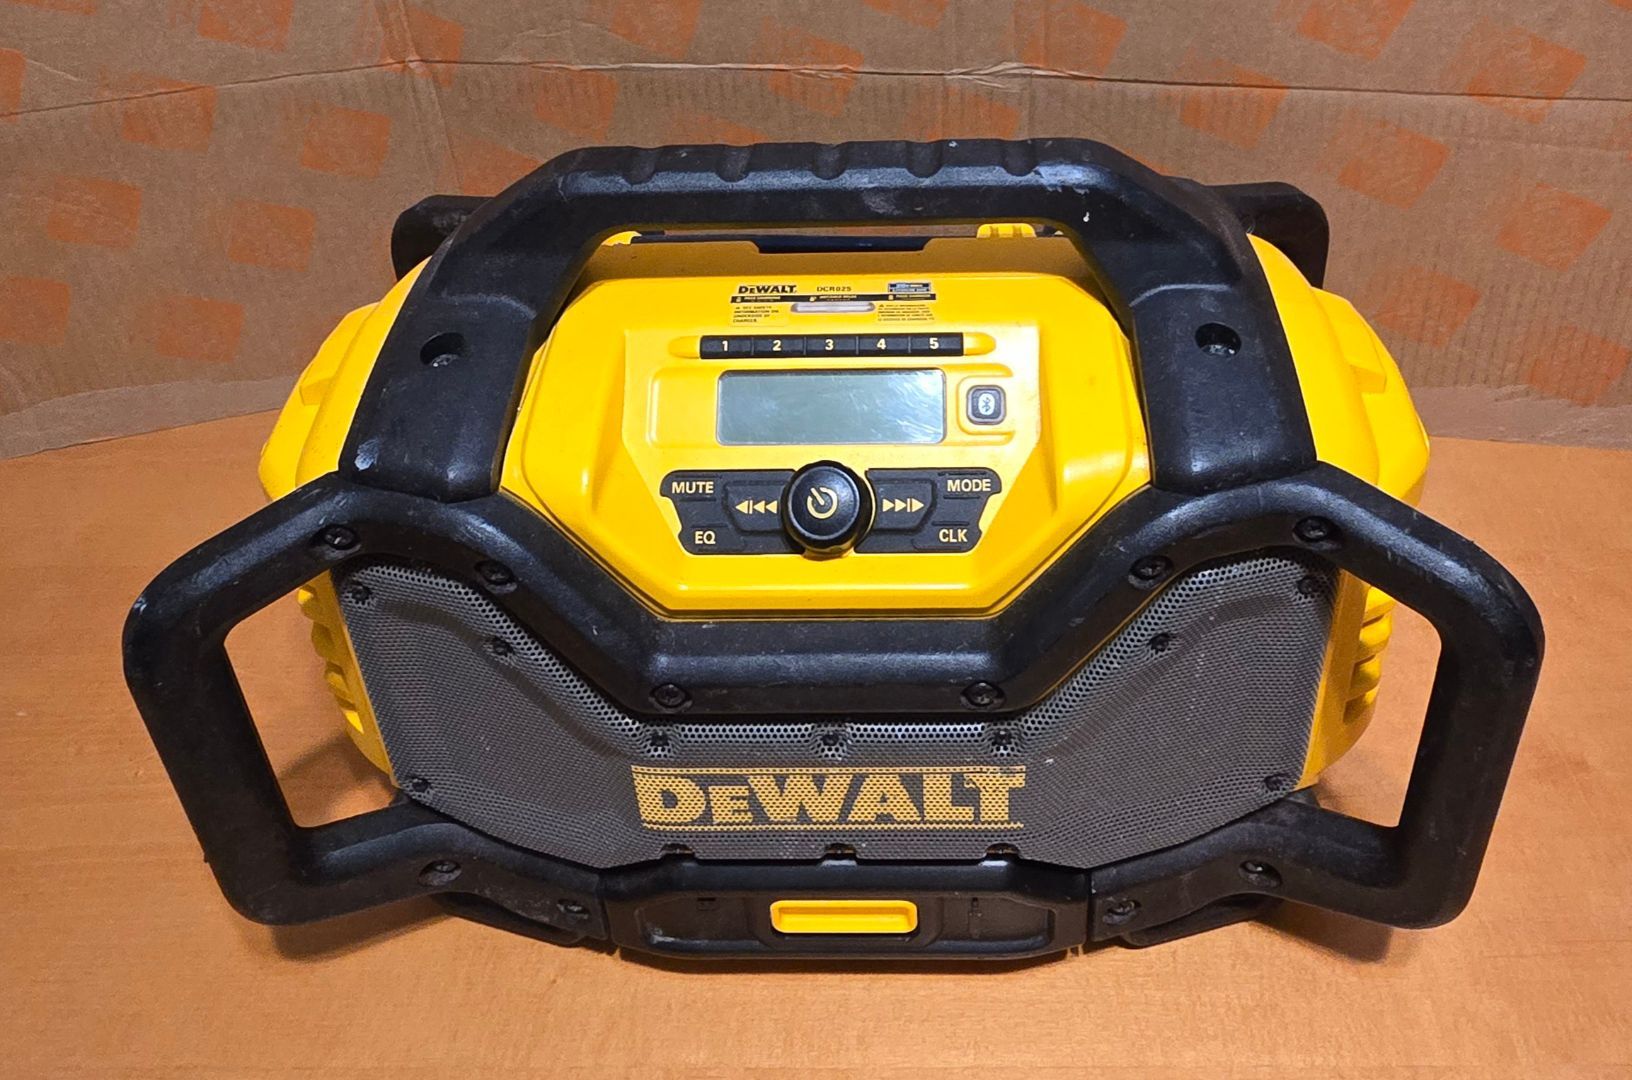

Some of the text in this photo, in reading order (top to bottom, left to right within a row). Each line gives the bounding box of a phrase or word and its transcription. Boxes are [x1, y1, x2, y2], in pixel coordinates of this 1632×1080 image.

[738, 285, 797, 294] DEWALT
[722, 338, 939, 351] 1 2 3 4 5
[671, 481, 714, 494] MUTE
[947, 479, 992, 492] MODE
[695, 531, 716, 545] EQ
[939, 529, 968, 542] CLK
[632, 771, 1026, 825] DEWALT
